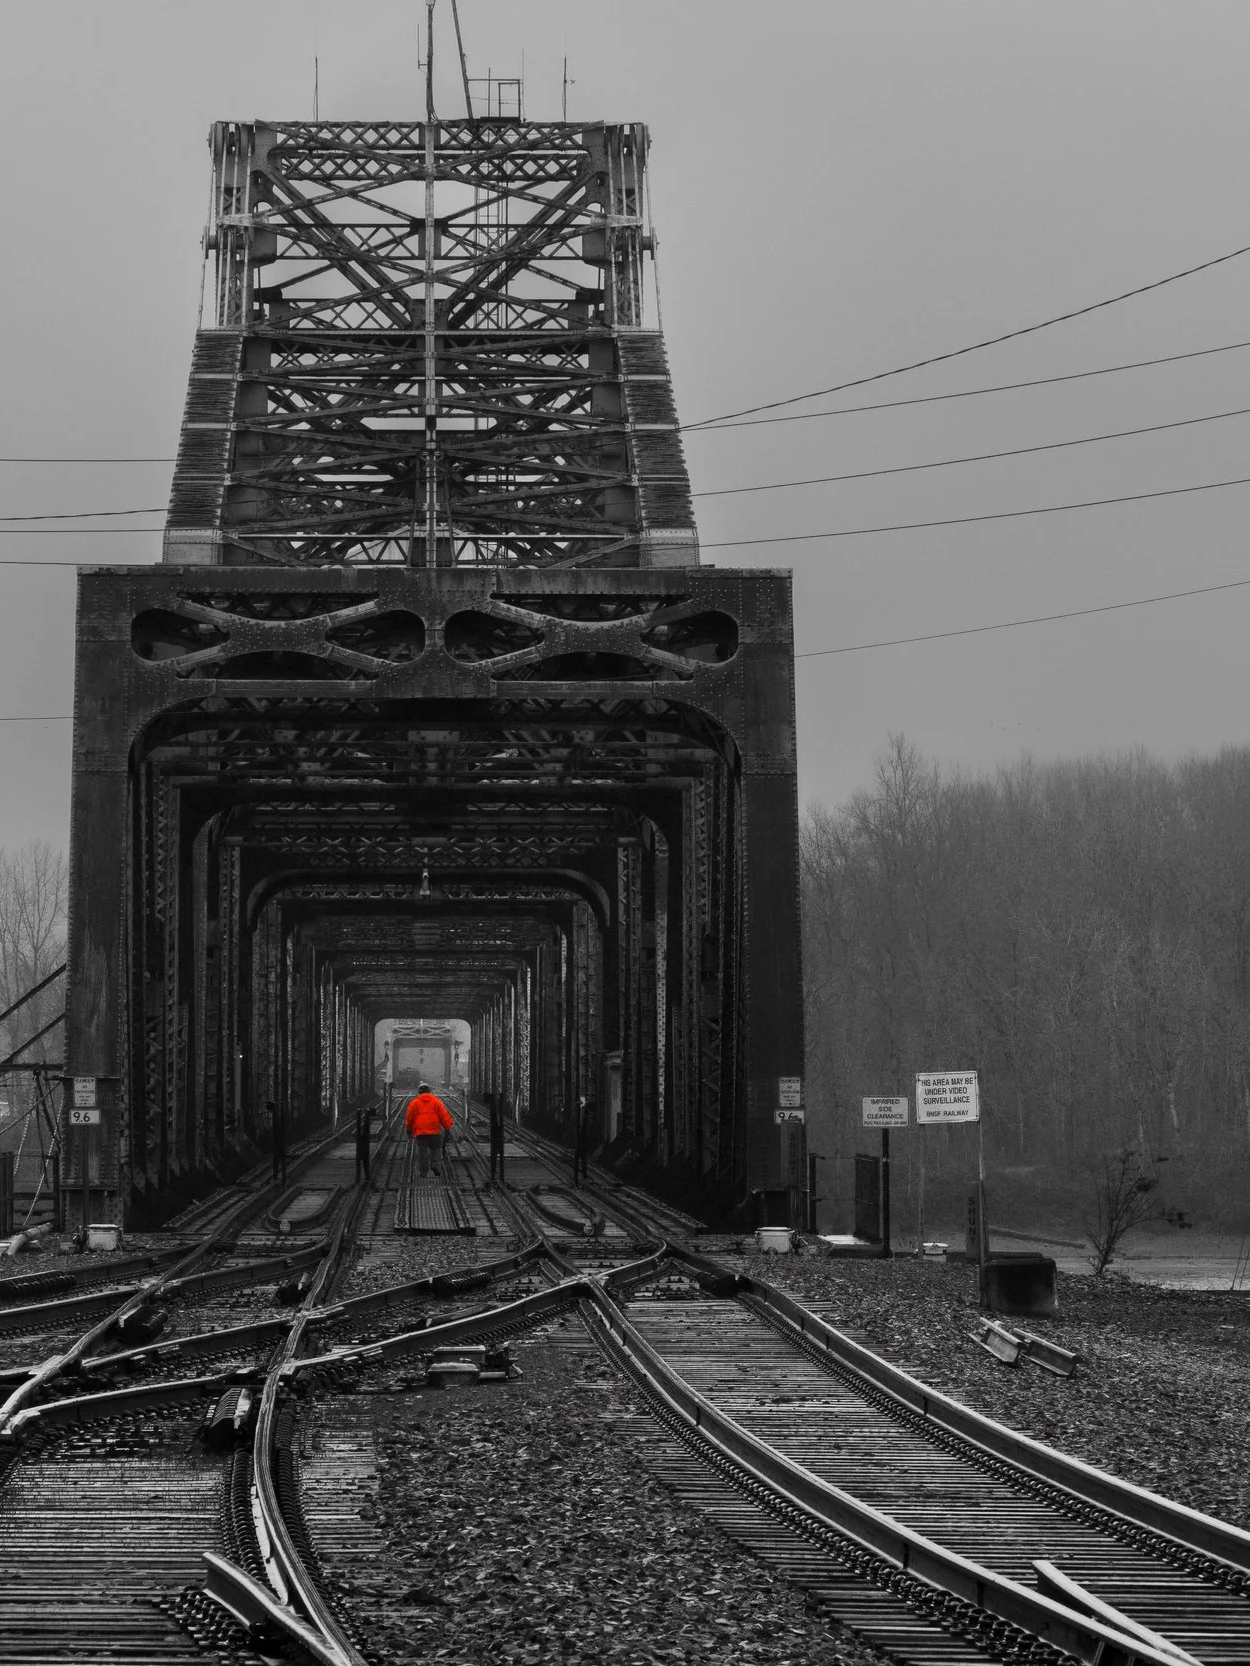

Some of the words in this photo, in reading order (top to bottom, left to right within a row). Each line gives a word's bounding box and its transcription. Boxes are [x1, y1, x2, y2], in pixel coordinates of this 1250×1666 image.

[932, 1078, 950, 1086] AREA
[951, 1077, 963, 1085] MAY
[964, 1077, 973, 1085] BE
[924, 1087, 947, 1096] UNDER
[948, 1086, 968, 1095] VIDEO
[923, 1095, 971, 1105] SURVEILLANCE
[73, 1111, 91, 1122] 9.6
[926, 1110, 941, 1118] BNSF
[967, 1196, 977, 1245] SHUNT
